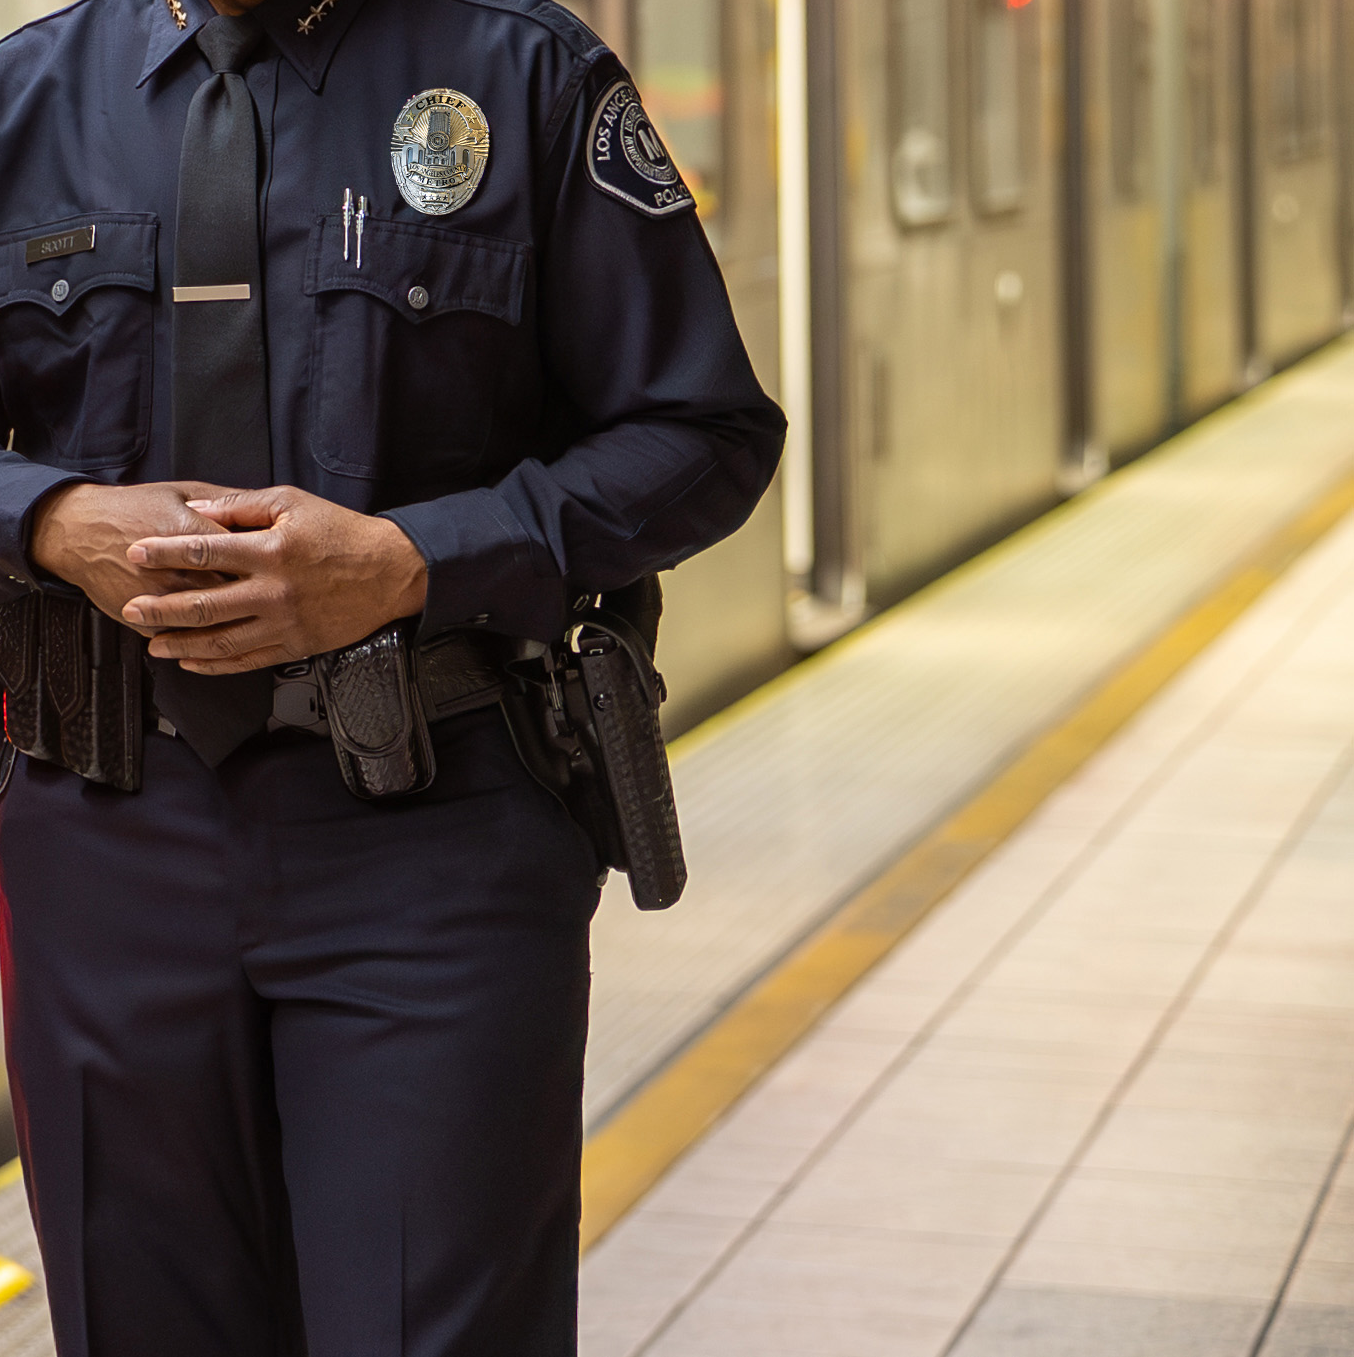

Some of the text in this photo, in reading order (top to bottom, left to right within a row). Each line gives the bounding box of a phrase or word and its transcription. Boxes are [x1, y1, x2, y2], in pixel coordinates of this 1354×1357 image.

[415, 94, 467, 111] CHIEF
[595, 126, 611, 161] LOS
[637, 126, 666, 161] M
[420, 166, 443, 178] ANGELES
[443, 164, 468, 177] COUNTY
[417, 175, 456, 186] METRO
[40, 236, 75, 254] SCOTT
